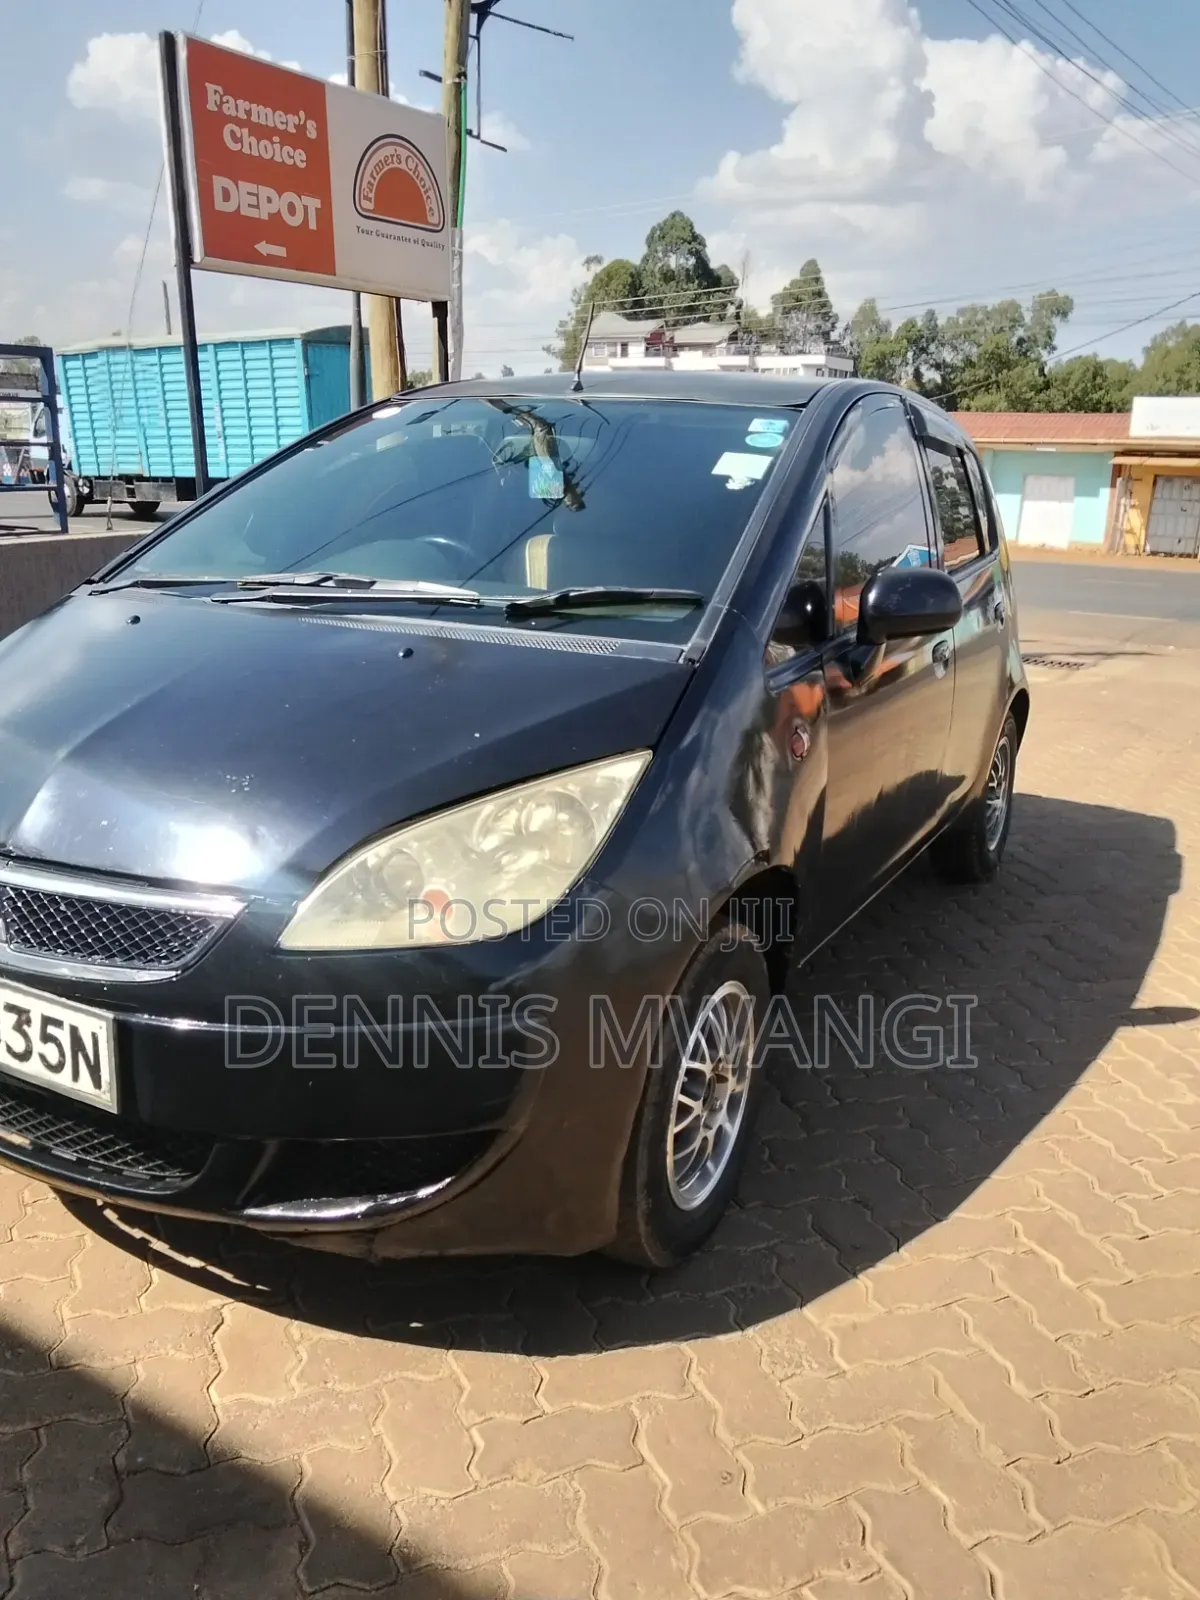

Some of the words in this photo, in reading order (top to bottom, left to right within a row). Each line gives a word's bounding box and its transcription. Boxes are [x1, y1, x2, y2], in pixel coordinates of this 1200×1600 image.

[205, 82, 317, 139] Farmer's
[223, 123, 307, 168] Choice
[212, 174, 321, 230] DEPOT
[363, 148, 402, 204] Farmer's
[405, 154, 435, 217] Choice
[356, 225, 374, 237] Your
[375, 230, 411, 243] Guarantee
[413, 237, 420, 245] of
[421, 238, 446, 251] Quality
[0, 1001, 102, 1091] 35N
